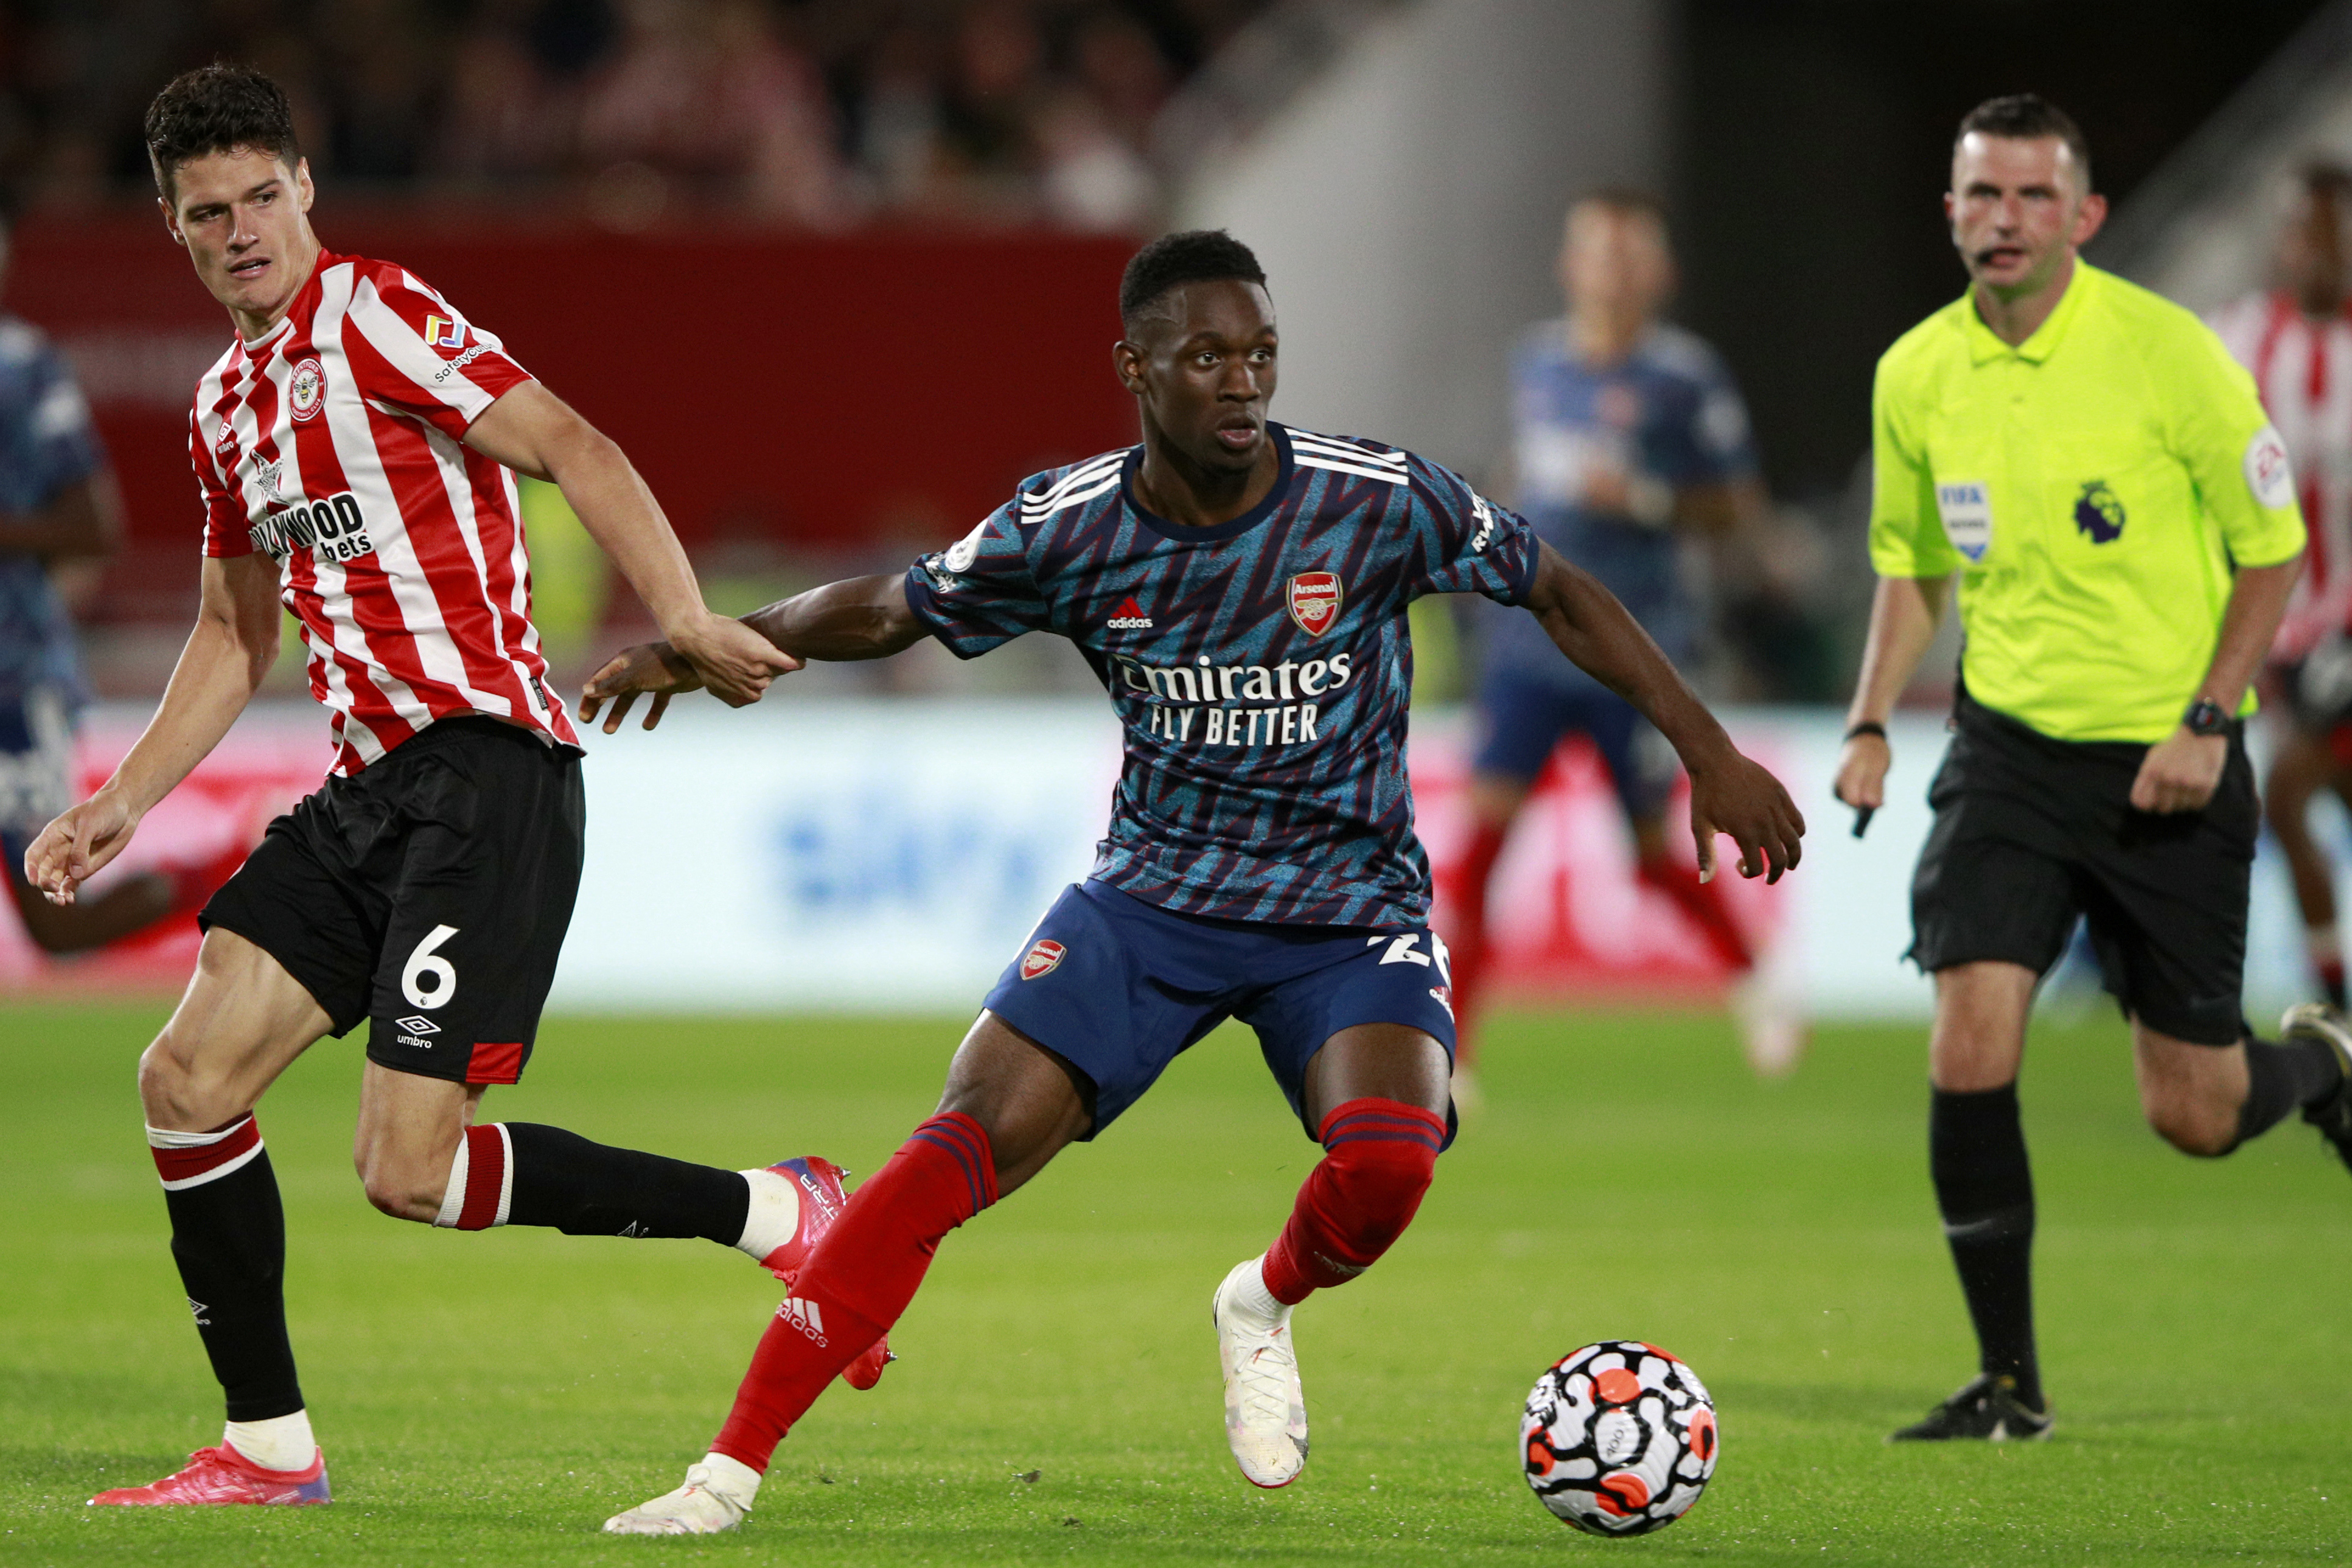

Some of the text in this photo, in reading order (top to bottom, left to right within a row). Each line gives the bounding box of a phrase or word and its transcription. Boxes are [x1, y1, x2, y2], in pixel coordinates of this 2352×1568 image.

[319, 534, 372, 562] bets
[1294, 581, 1335, 594] Arsenal
[1107, 616, 1154, 629] adidas
[1111, 652, 1352, 702] Emirates
[1150, 703, 1318, 747] FLY BETTER
[1035, 944, 1061, 958] Arsenal
[402, 923, 461, 1009] 6
[397, 1034, 433, 1049] umbro
